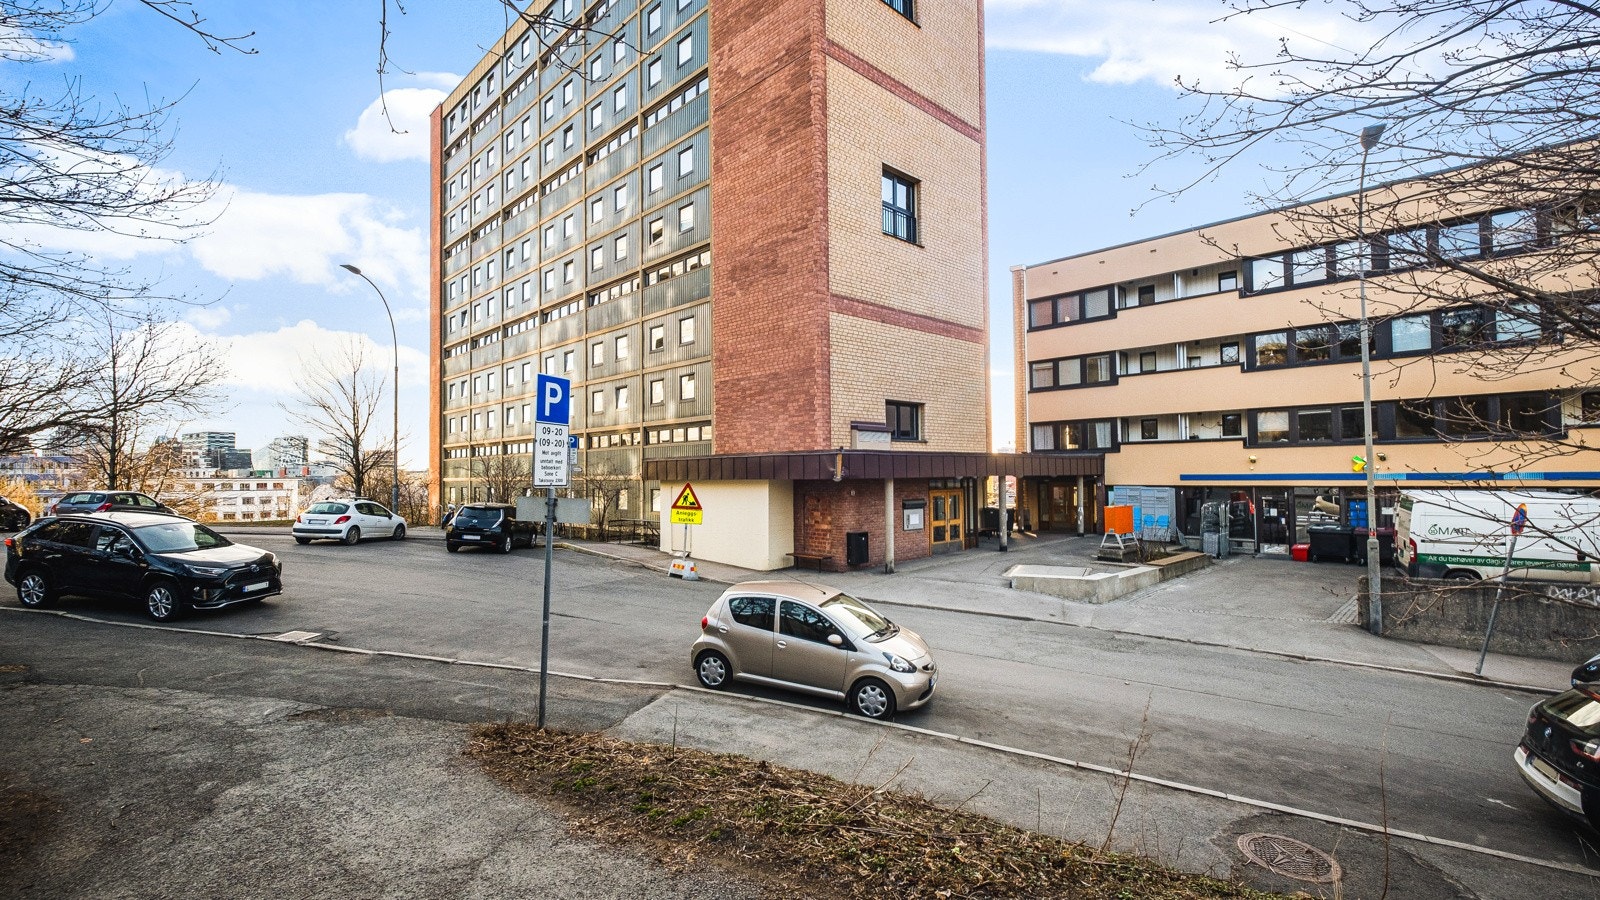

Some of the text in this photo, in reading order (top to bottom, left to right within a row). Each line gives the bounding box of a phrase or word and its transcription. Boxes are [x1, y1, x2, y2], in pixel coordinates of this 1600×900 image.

[545, 381, 562, 417] P
[542, 426, 563, 436] 09-20
[539, 437, 565, 448] (09-20)
